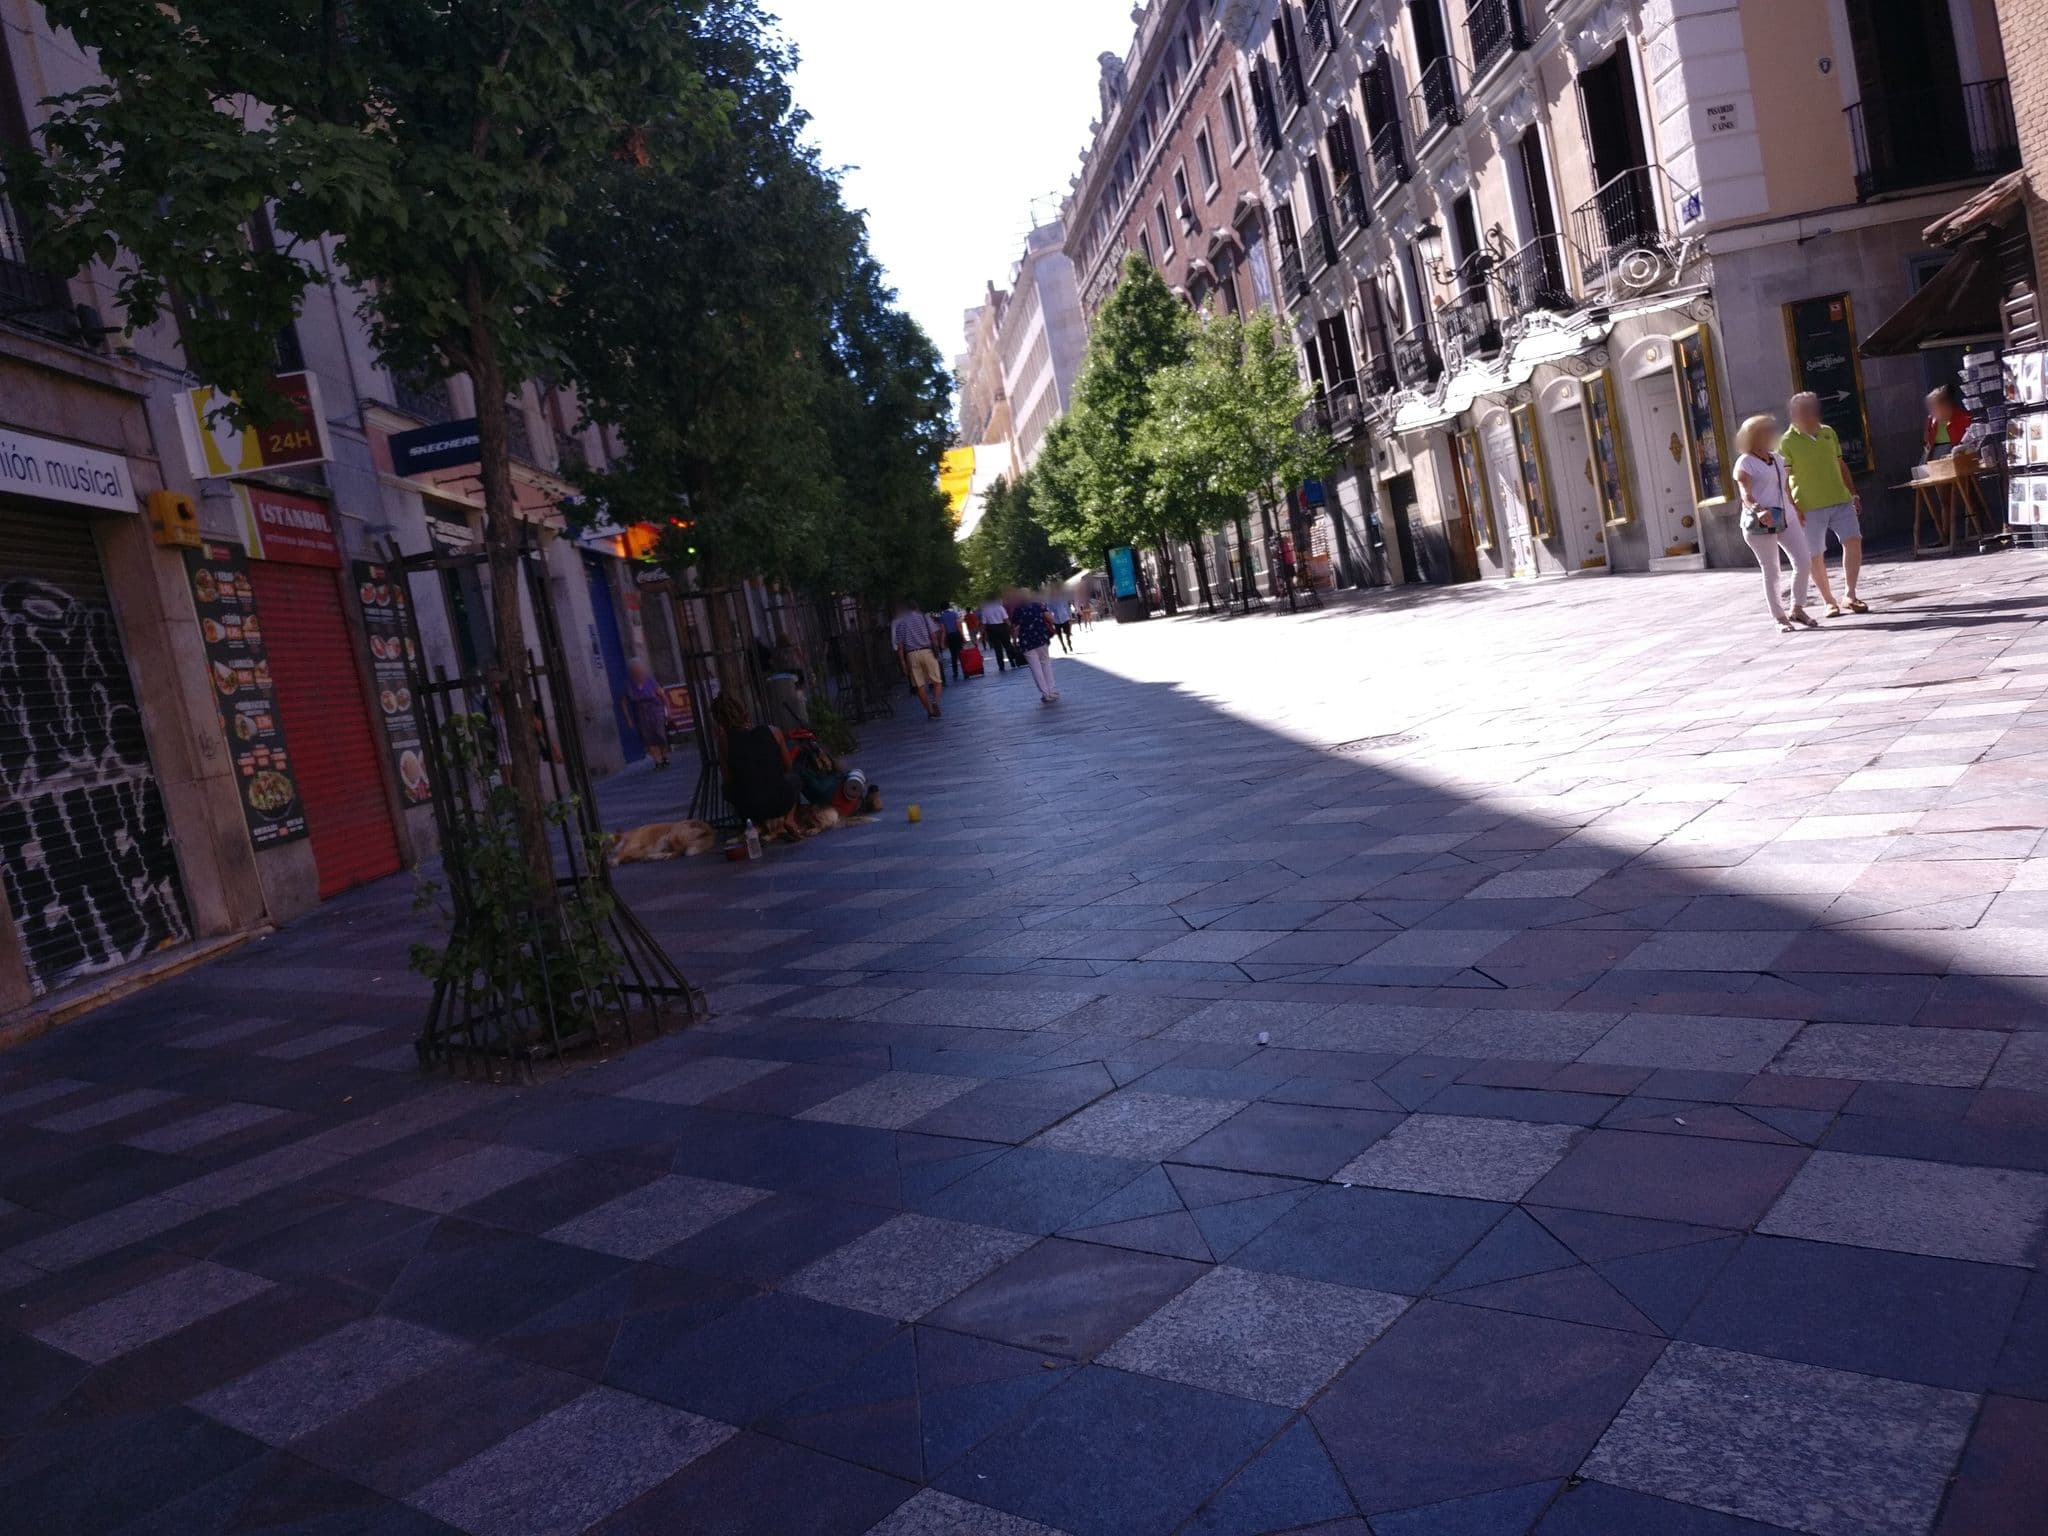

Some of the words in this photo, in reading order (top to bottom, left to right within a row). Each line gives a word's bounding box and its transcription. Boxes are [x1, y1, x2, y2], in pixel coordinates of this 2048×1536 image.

[269, 430, 313, 454] 24H
[408, 434, 480, 457] SKECHERS
[45, 460, 123, 497] musical
[258, 503, 332, 533] ISTANBUL
